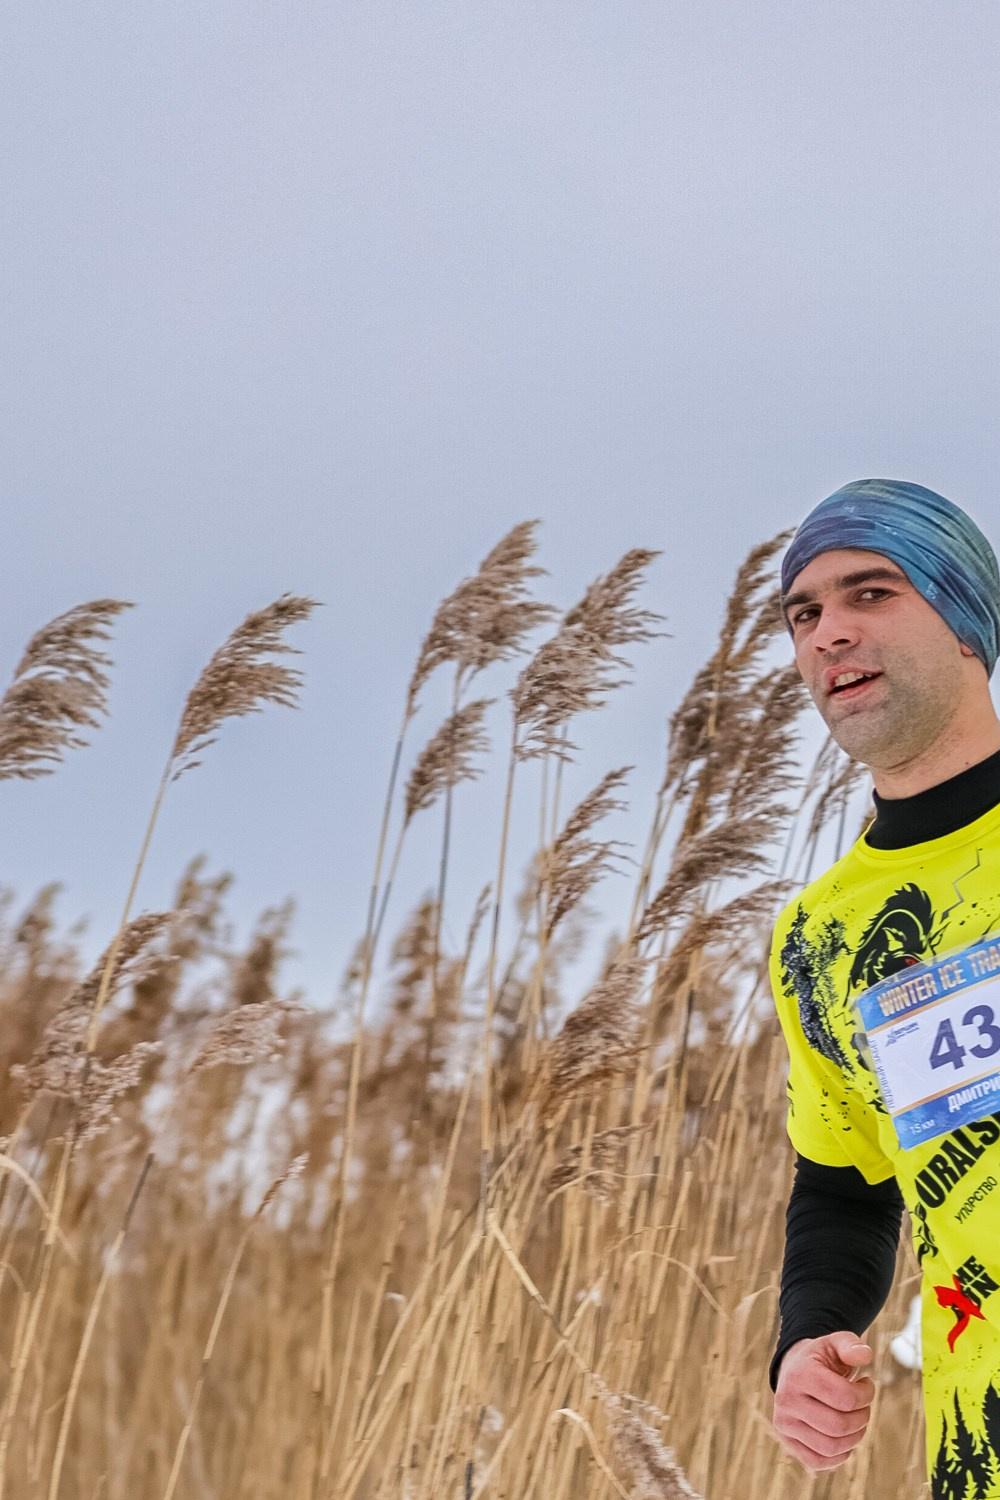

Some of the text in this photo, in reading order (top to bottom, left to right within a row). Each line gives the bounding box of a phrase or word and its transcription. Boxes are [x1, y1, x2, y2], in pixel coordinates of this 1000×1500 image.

[877, 973, 938, 1017] WINTER
[938, 960, 967, 991] ICE
[954, 1176, 998, 1224] УПОРСТВО
